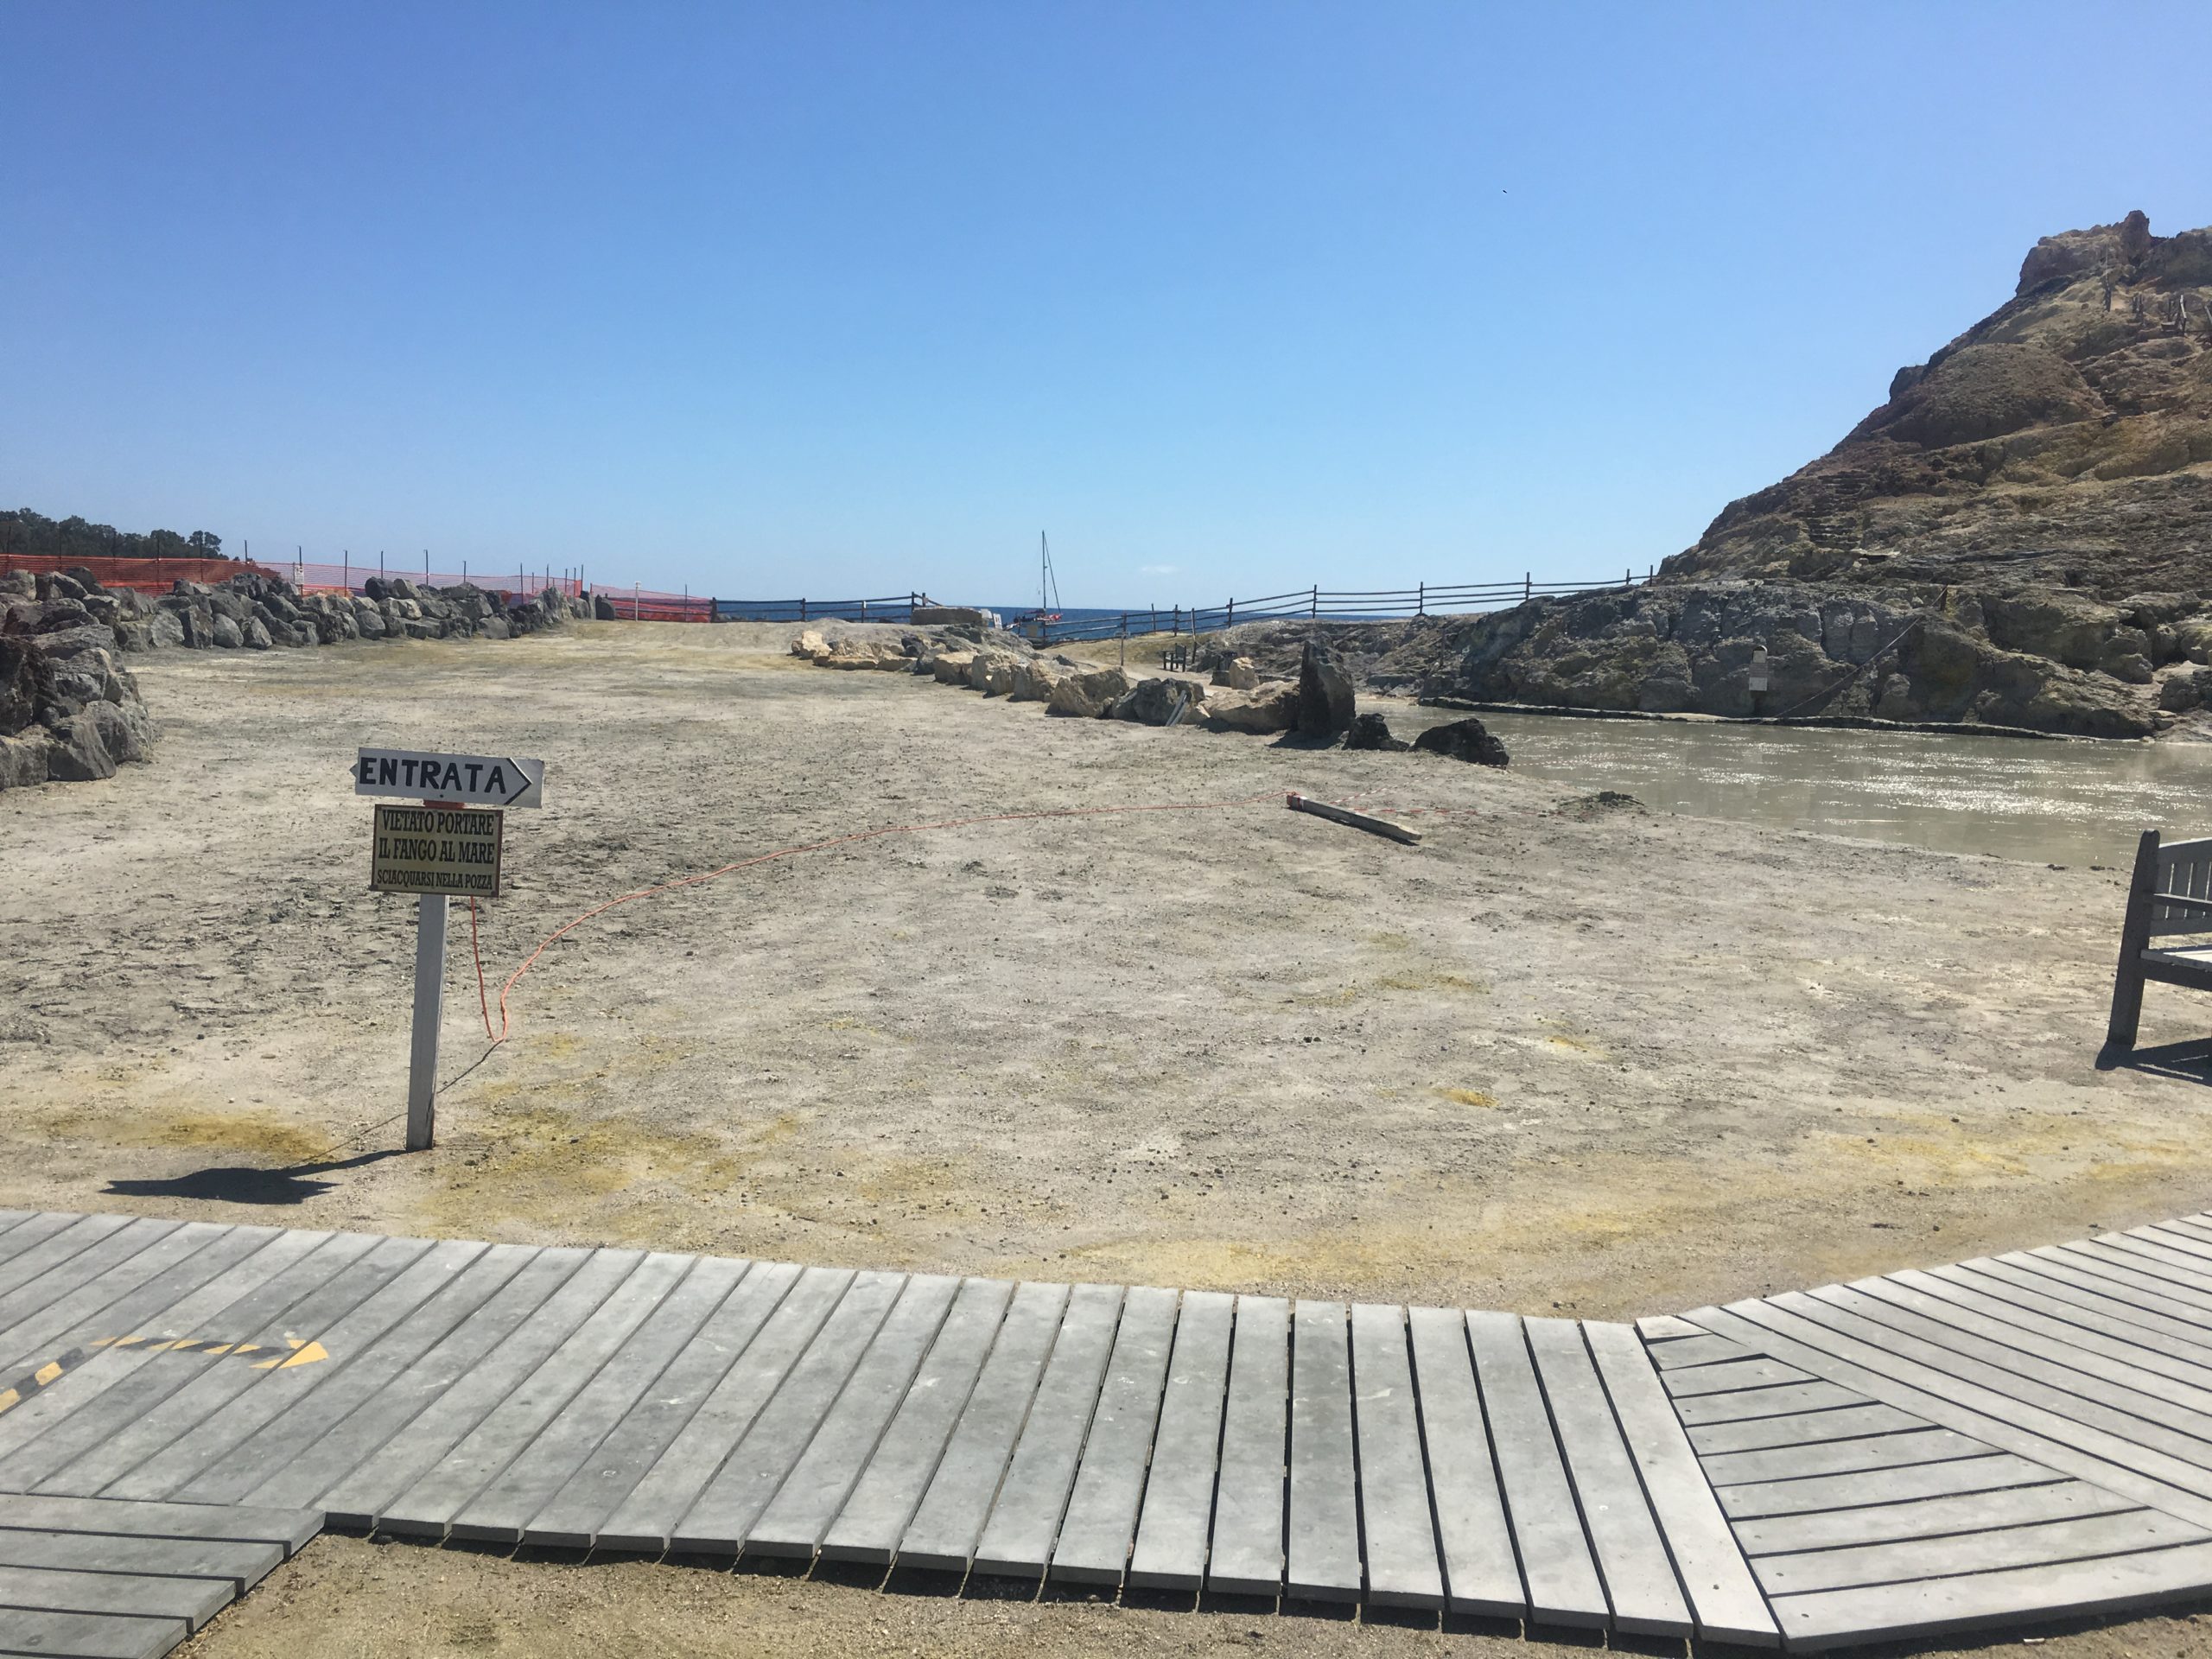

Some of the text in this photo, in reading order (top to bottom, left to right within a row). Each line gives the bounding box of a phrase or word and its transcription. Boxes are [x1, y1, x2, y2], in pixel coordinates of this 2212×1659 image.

[359, 757, 506, 794] ENTRATA
[383, 809, 494, 836] VIETATO PORTARE
[378, 836, 495, 864] IL FANGO AL MARE
[377, 869, 493, 890] SCIACQUARSI NELLA POZZA
